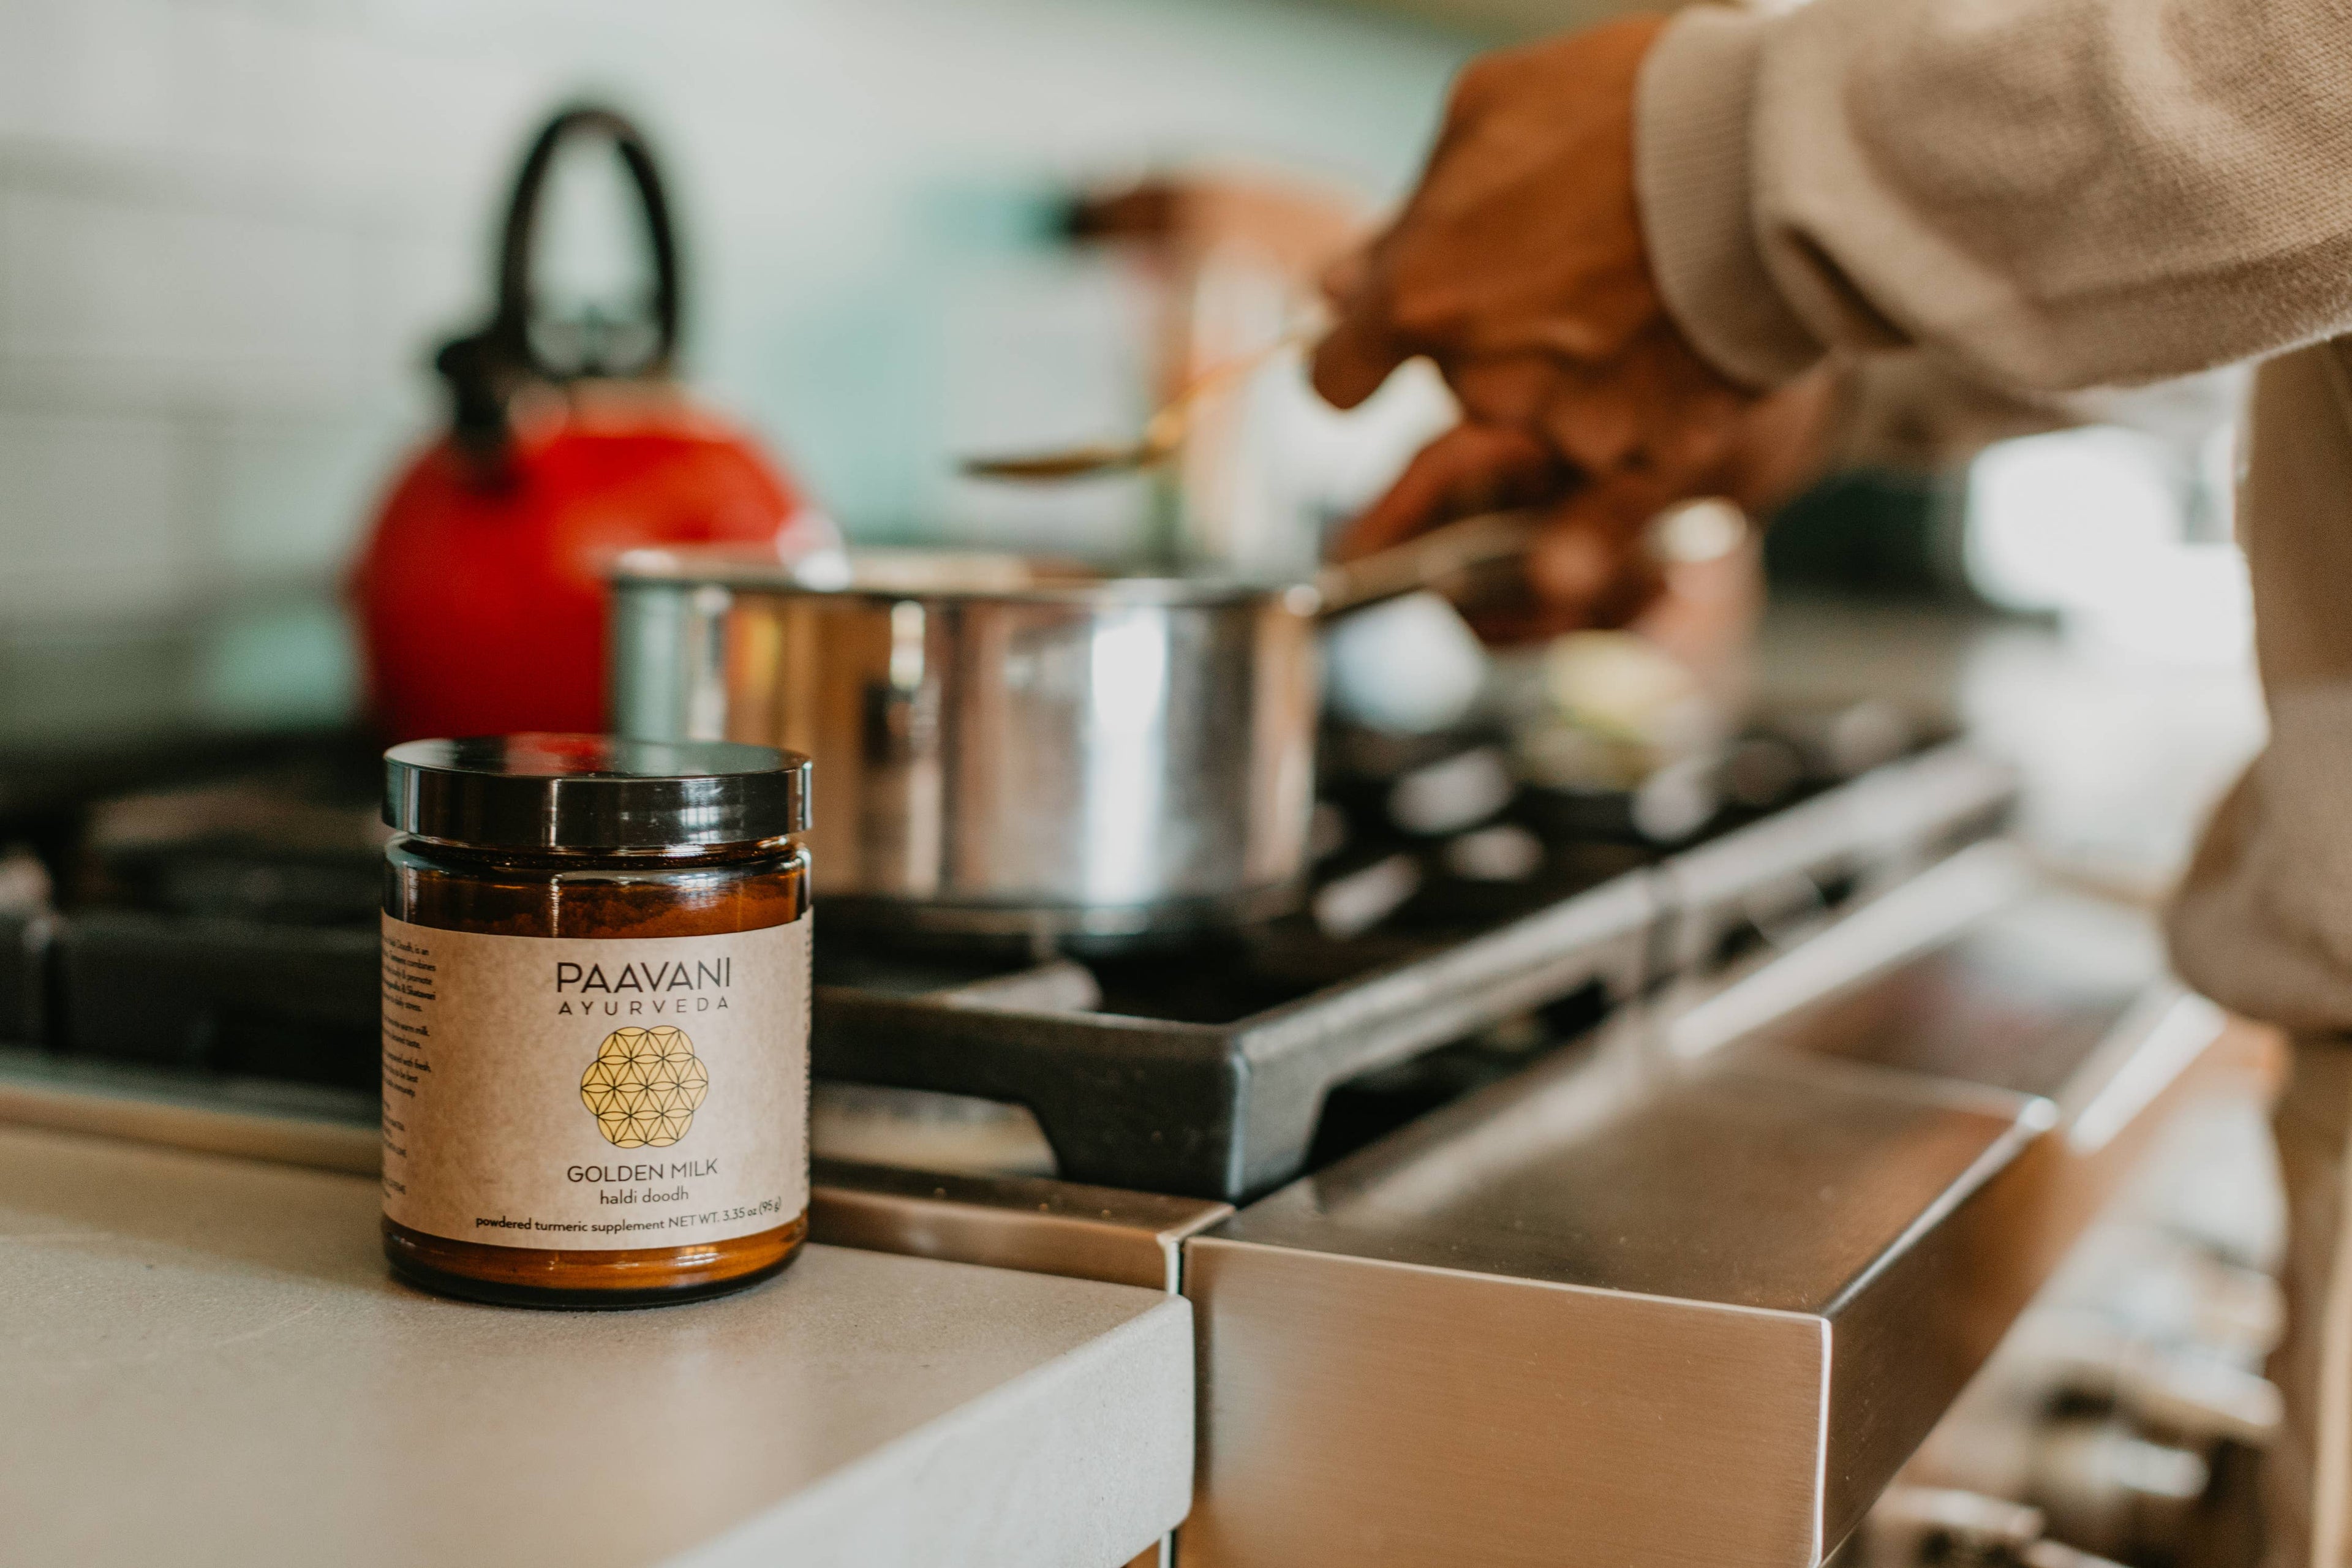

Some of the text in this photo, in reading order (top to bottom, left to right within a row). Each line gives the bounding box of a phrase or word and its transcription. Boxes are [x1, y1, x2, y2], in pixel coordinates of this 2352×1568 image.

[557, 957, 730, 993] PAAVANI
[558, 995, 729, 1016] AYURVEDA
[567, 1158, 718, 1183] GOLDEN MILK
[600, 1186, 689, 1205] haldi doodh
[475, 1215, 532, 1231] powdered
[535, 1221, 588, 1232] turmeric
[591, 1219, 665, 1235] supplement
[668, 1215, 697, 1228] NET
[698, 1212, 720, 1224] WT.
[723, 1207, 745, 1221] 3.35
[747, 1208, 757, 1216] oz
